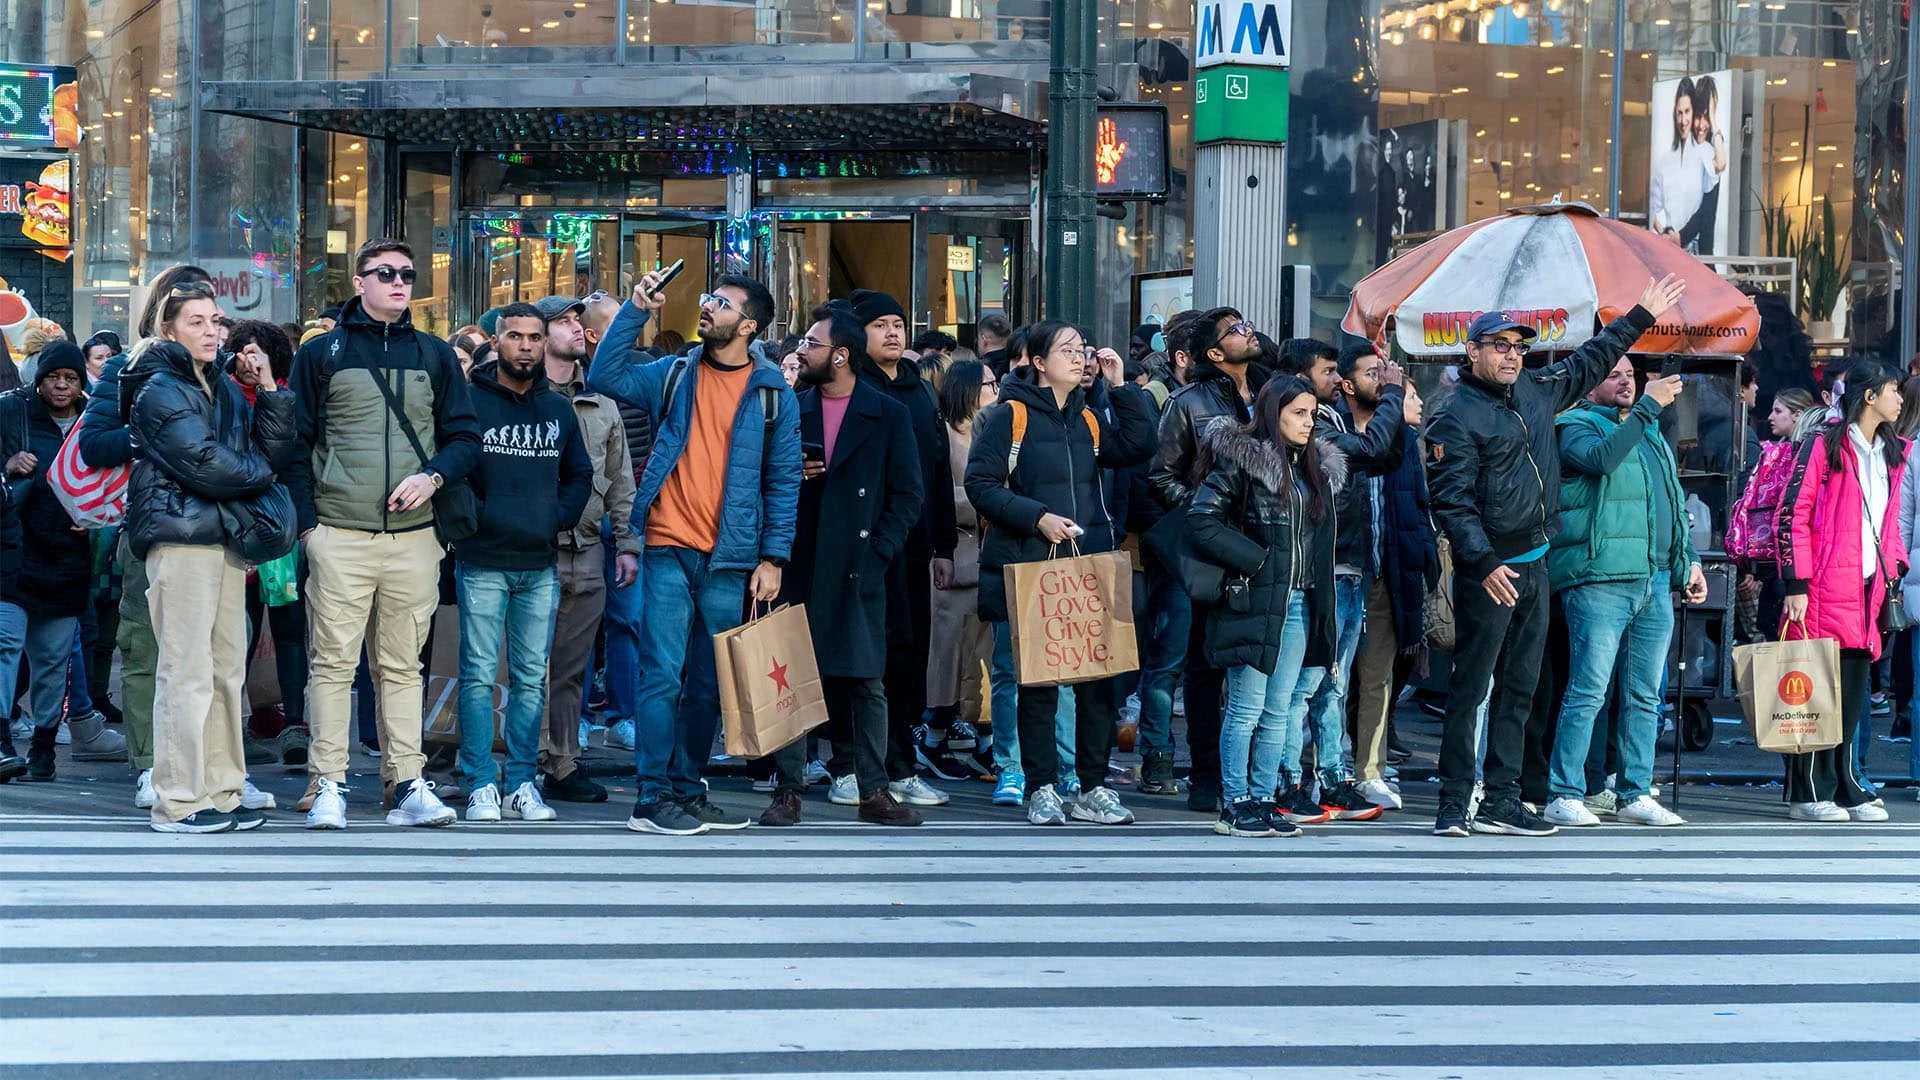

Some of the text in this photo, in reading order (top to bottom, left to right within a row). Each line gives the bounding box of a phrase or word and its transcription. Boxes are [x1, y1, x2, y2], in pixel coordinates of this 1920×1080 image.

[1640, 323, 1747, 338] .nuts4nuts.com
[483, 444, 560, 457] EVOLUTION JUDO
[1039, 569, 1099, 595] Give
[1039, 594, 1107, 618] Love.
[1045, 616, 1104, 642] Give
[1045, 638, 1114, 671] Style.
